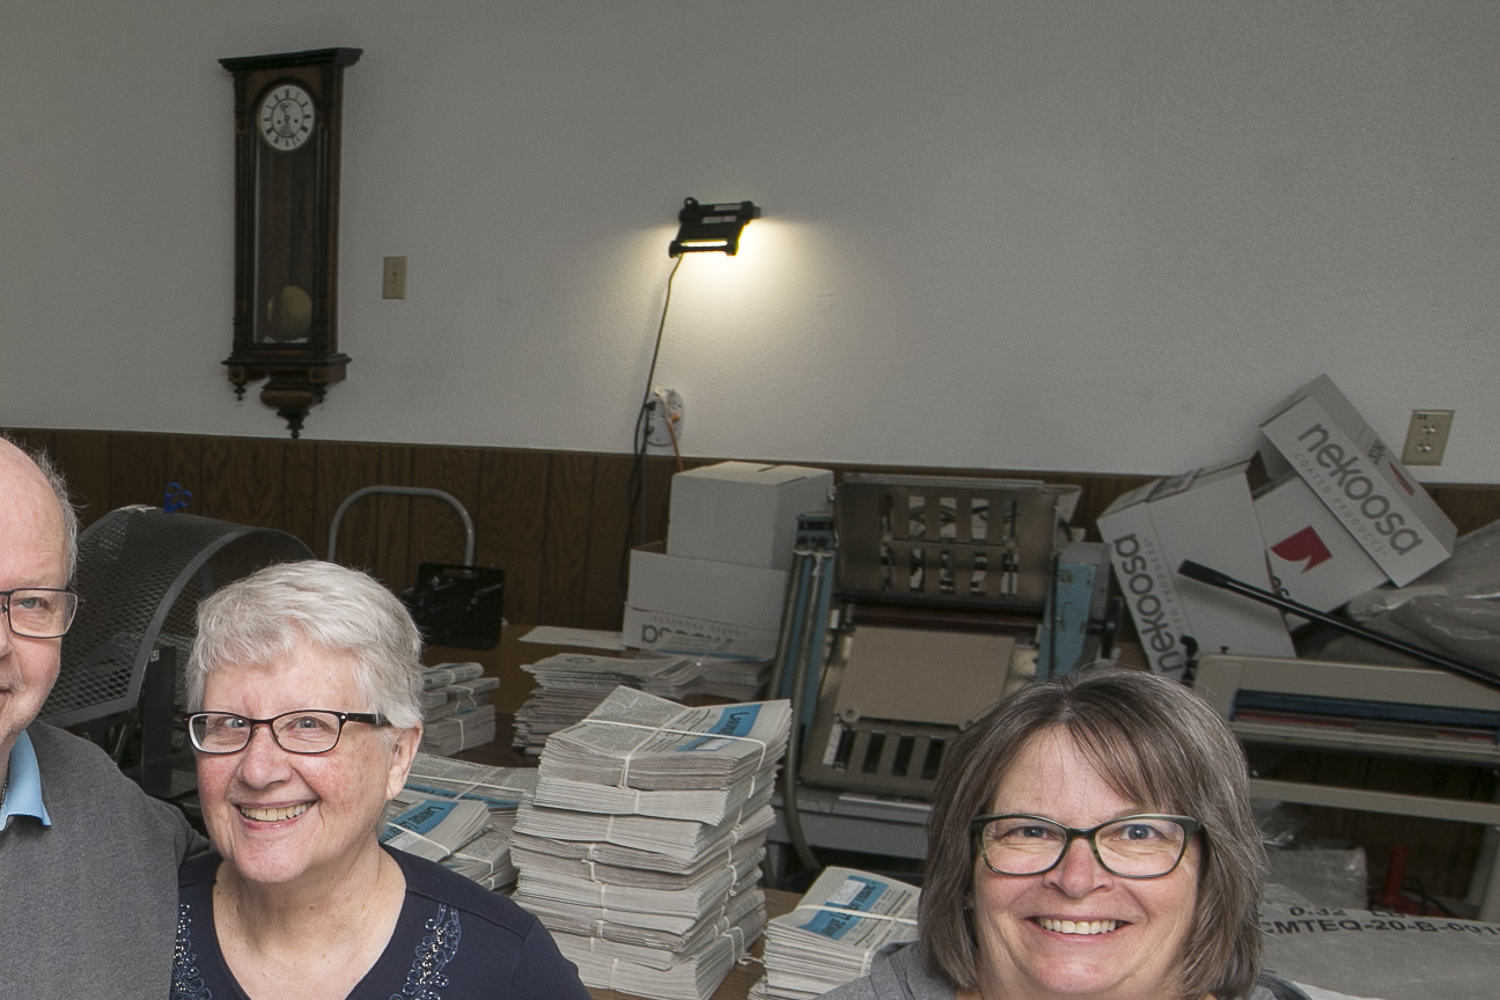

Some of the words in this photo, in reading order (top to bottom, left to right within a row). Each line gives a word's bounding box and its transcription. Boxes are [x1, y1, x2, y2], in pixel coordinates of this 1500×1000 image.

[1297, 423, 1422, 556] nekoosa
[1114, 533, 1183, 674] nekoosa
[1261, 919, 1500, 935] CMTEQ-20-B-001
